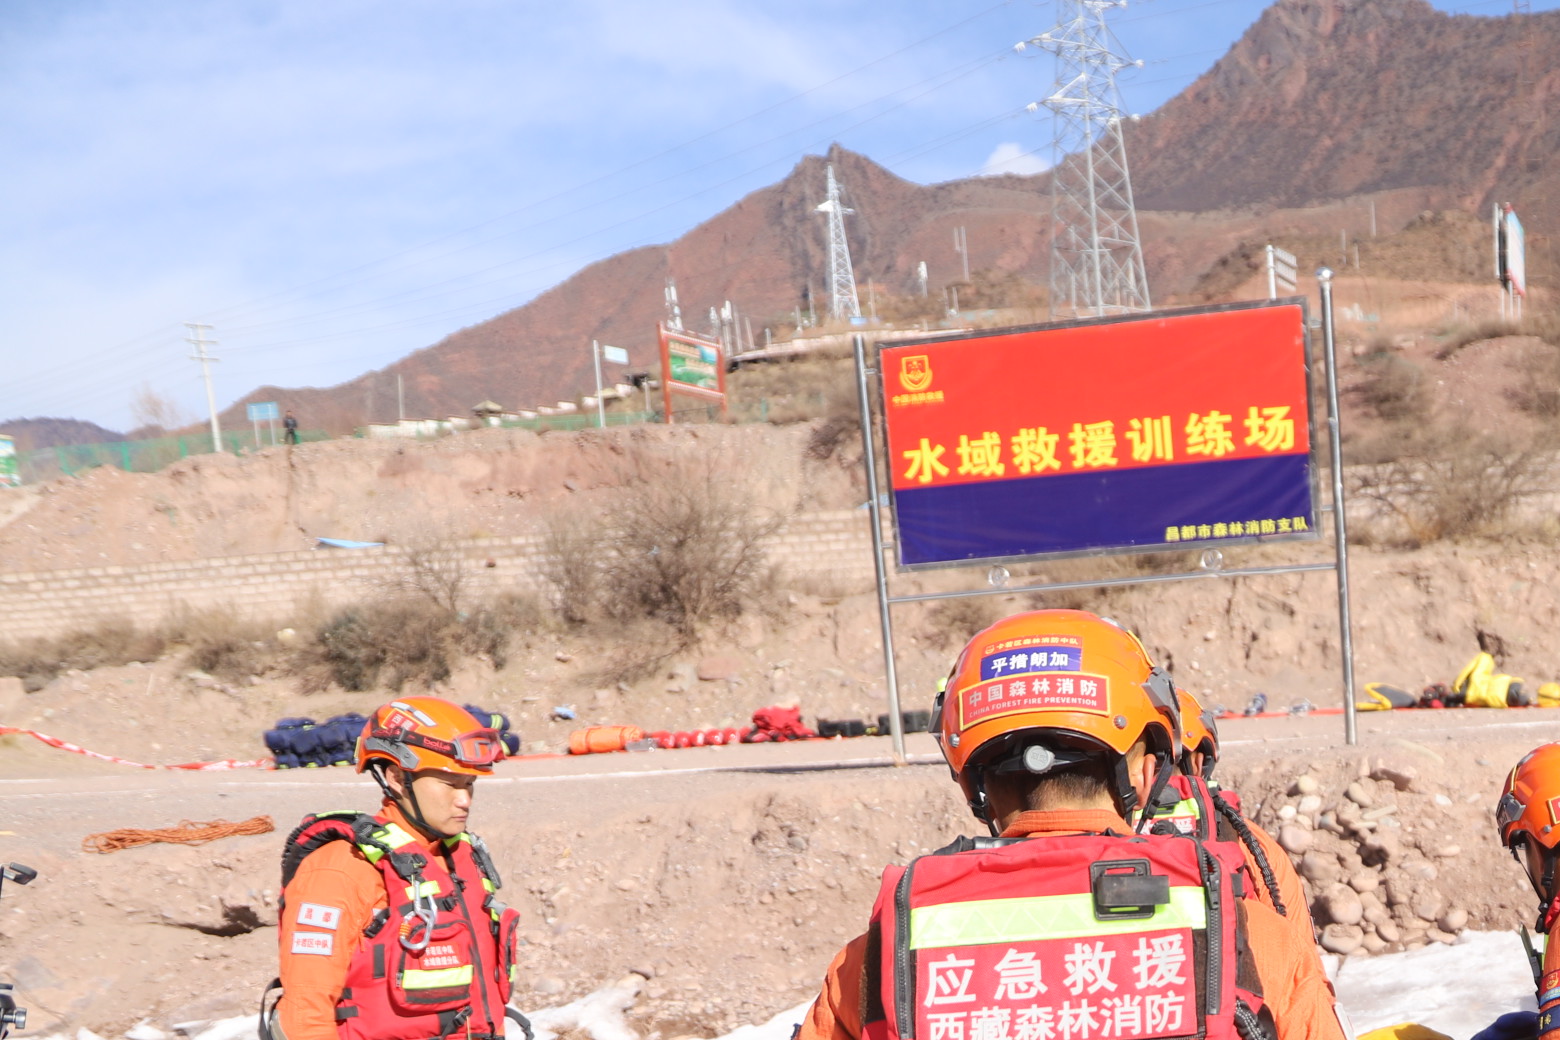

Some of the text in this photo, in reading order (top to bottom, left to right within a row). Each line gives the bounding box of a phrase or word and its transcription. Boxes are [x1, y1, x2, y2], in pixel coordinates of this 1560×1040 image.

[903, 406, 1295, 483] 水域救援训练场
[1165, 516, 1308, 542] 昌都市森林消防支队
[991, 651, 1069, 673] 平措朗加
[969, 678, 1097, 708] 中国森林消防
[969, 696, 1097, 718] CHINA FOREST FIRE PREVENTION
[924, 933, 1188, 1008] 应急救援
